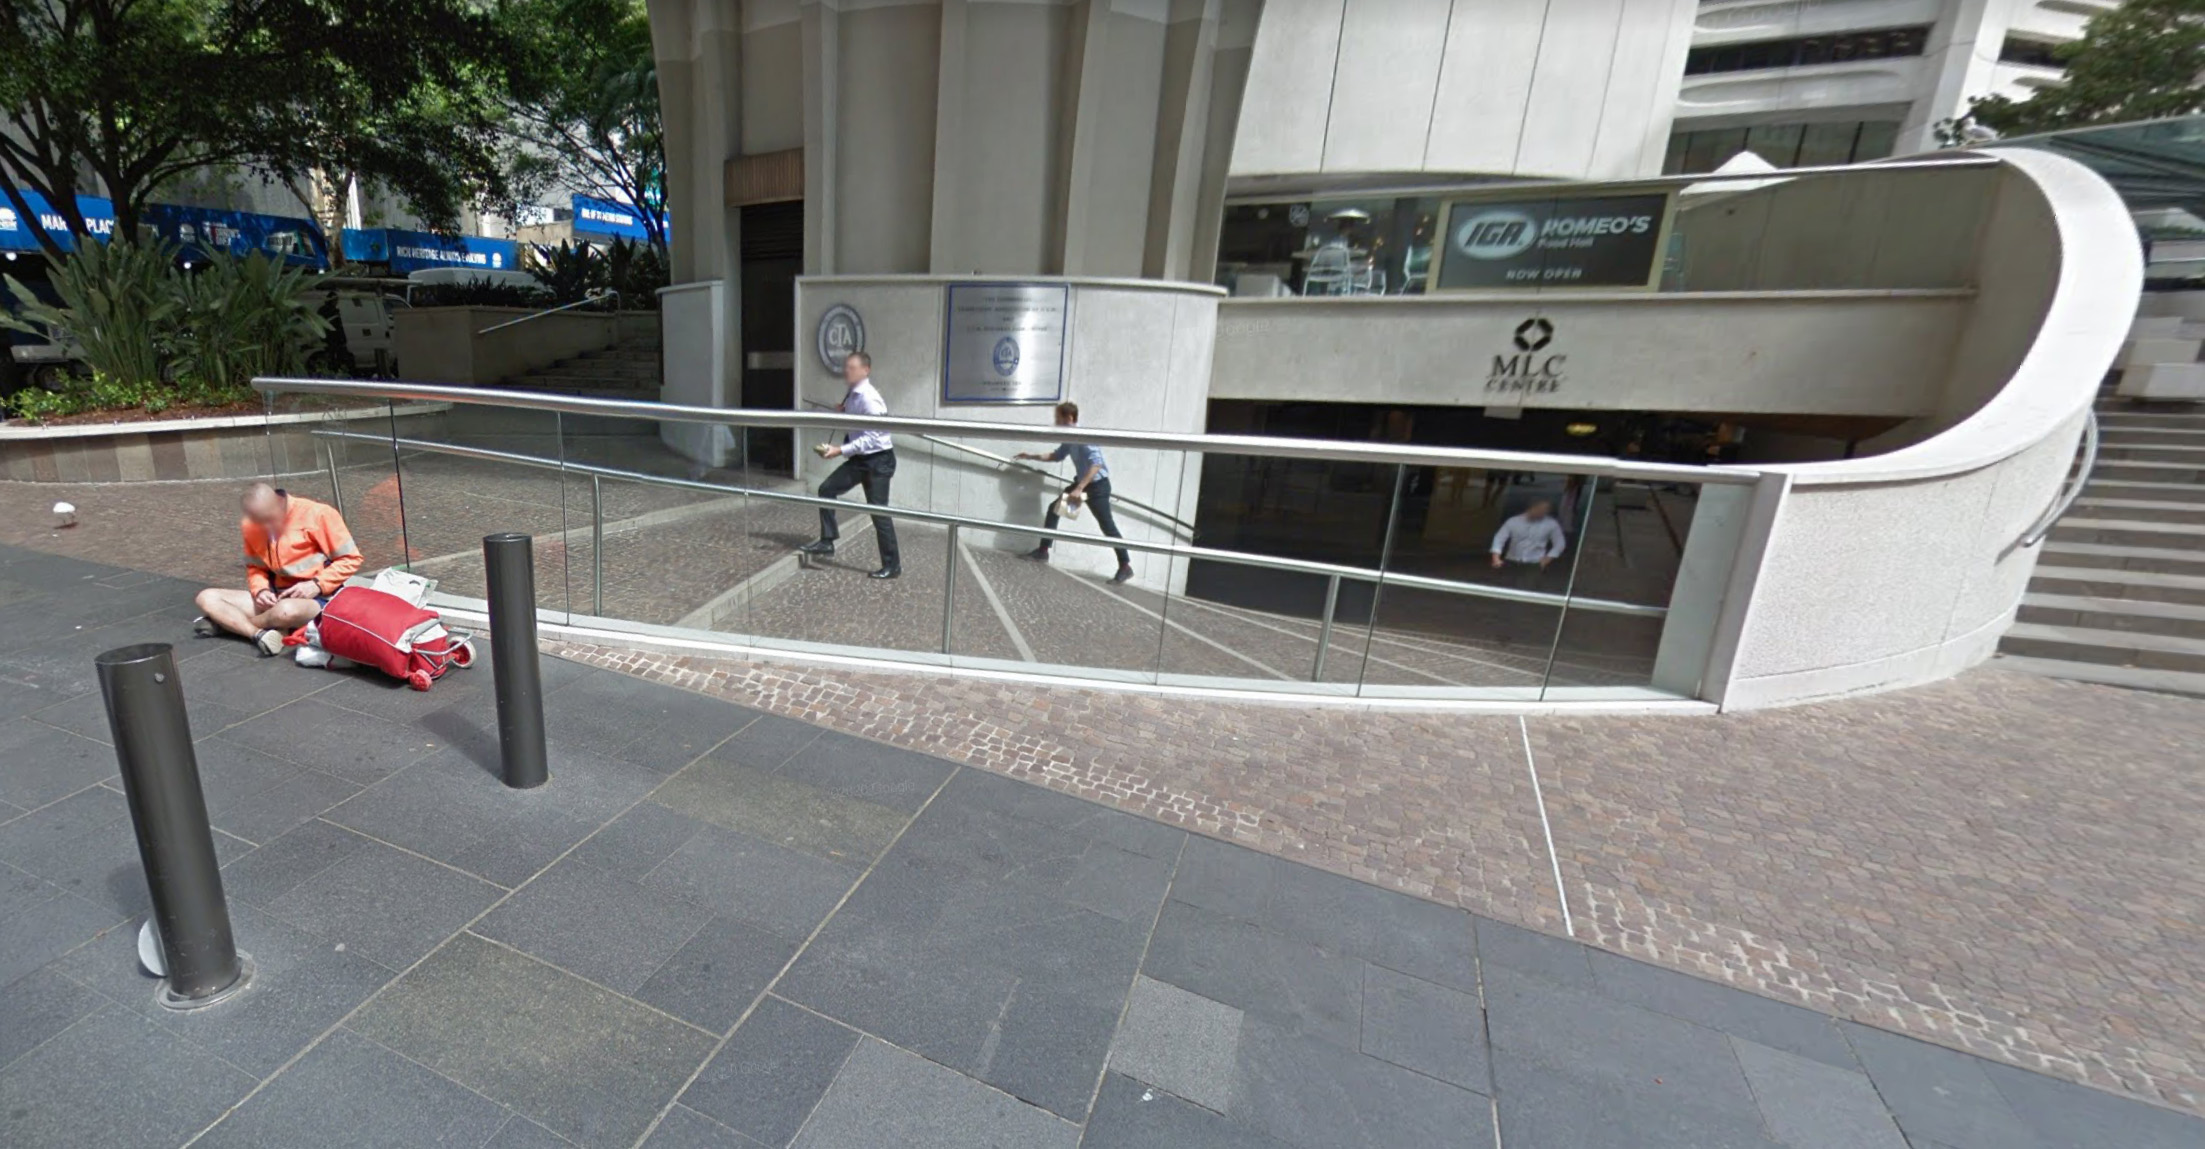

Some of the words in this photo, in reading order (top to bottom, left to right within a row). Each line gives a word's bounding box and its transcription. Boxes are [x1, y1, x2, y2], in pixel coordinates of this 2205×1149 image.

[85, 217, 115, 234] PLAC
[1464, 222, 1527, 248] IGA
[1541, 215, 1652, 236] ROMEO'S
[1506, 269, 1540, 280] NOW
[1543, 267, 1582, 280] OPEN
[828, 324, 853, 347] CTA
[1490, 354, 1567, 378] MLC
[1484, 377, 1561, 393] CENTRE
